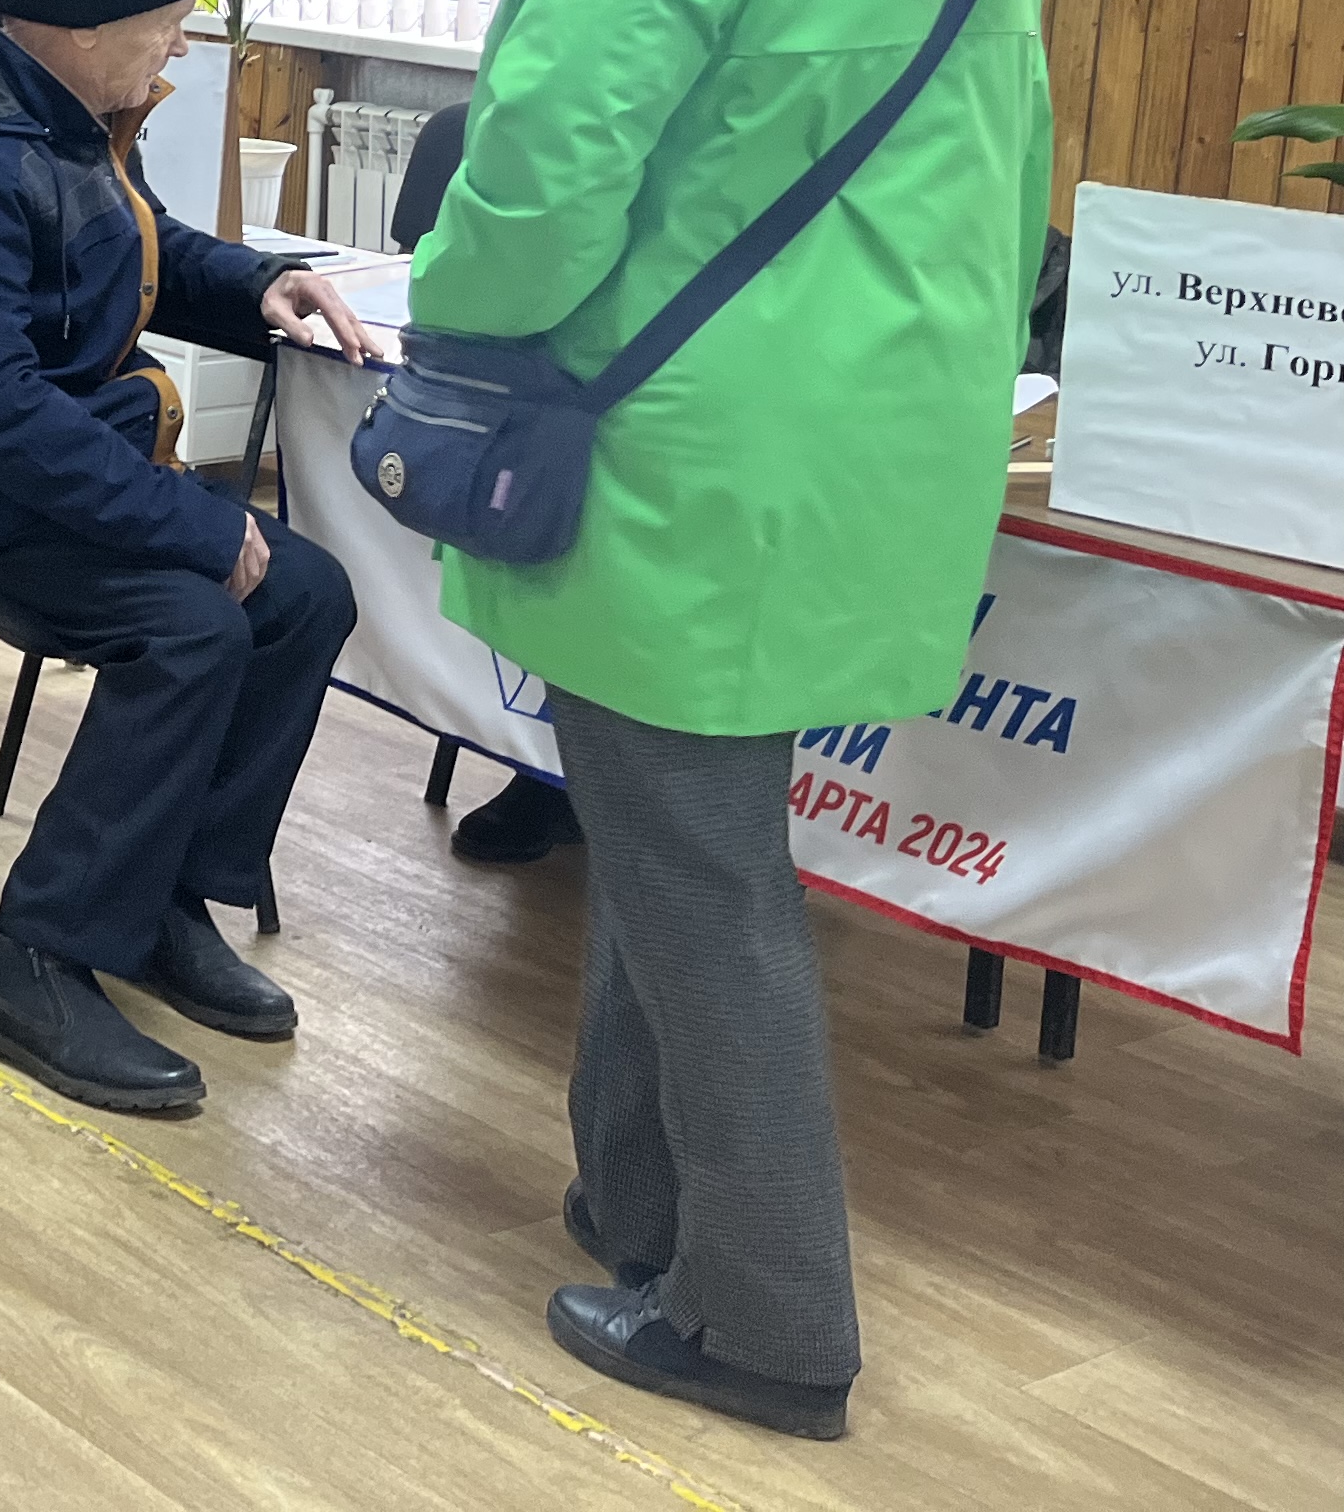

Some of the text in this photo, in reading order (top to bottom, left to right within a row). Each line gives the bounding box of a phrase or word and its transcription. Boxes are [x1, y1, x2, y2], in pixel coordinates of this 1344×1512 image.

[1110, 271, 1344, 323] ул. Верхнев
[1193, 341, 1247, 368] ул.
[897, 813, 1008, 886] 2024
